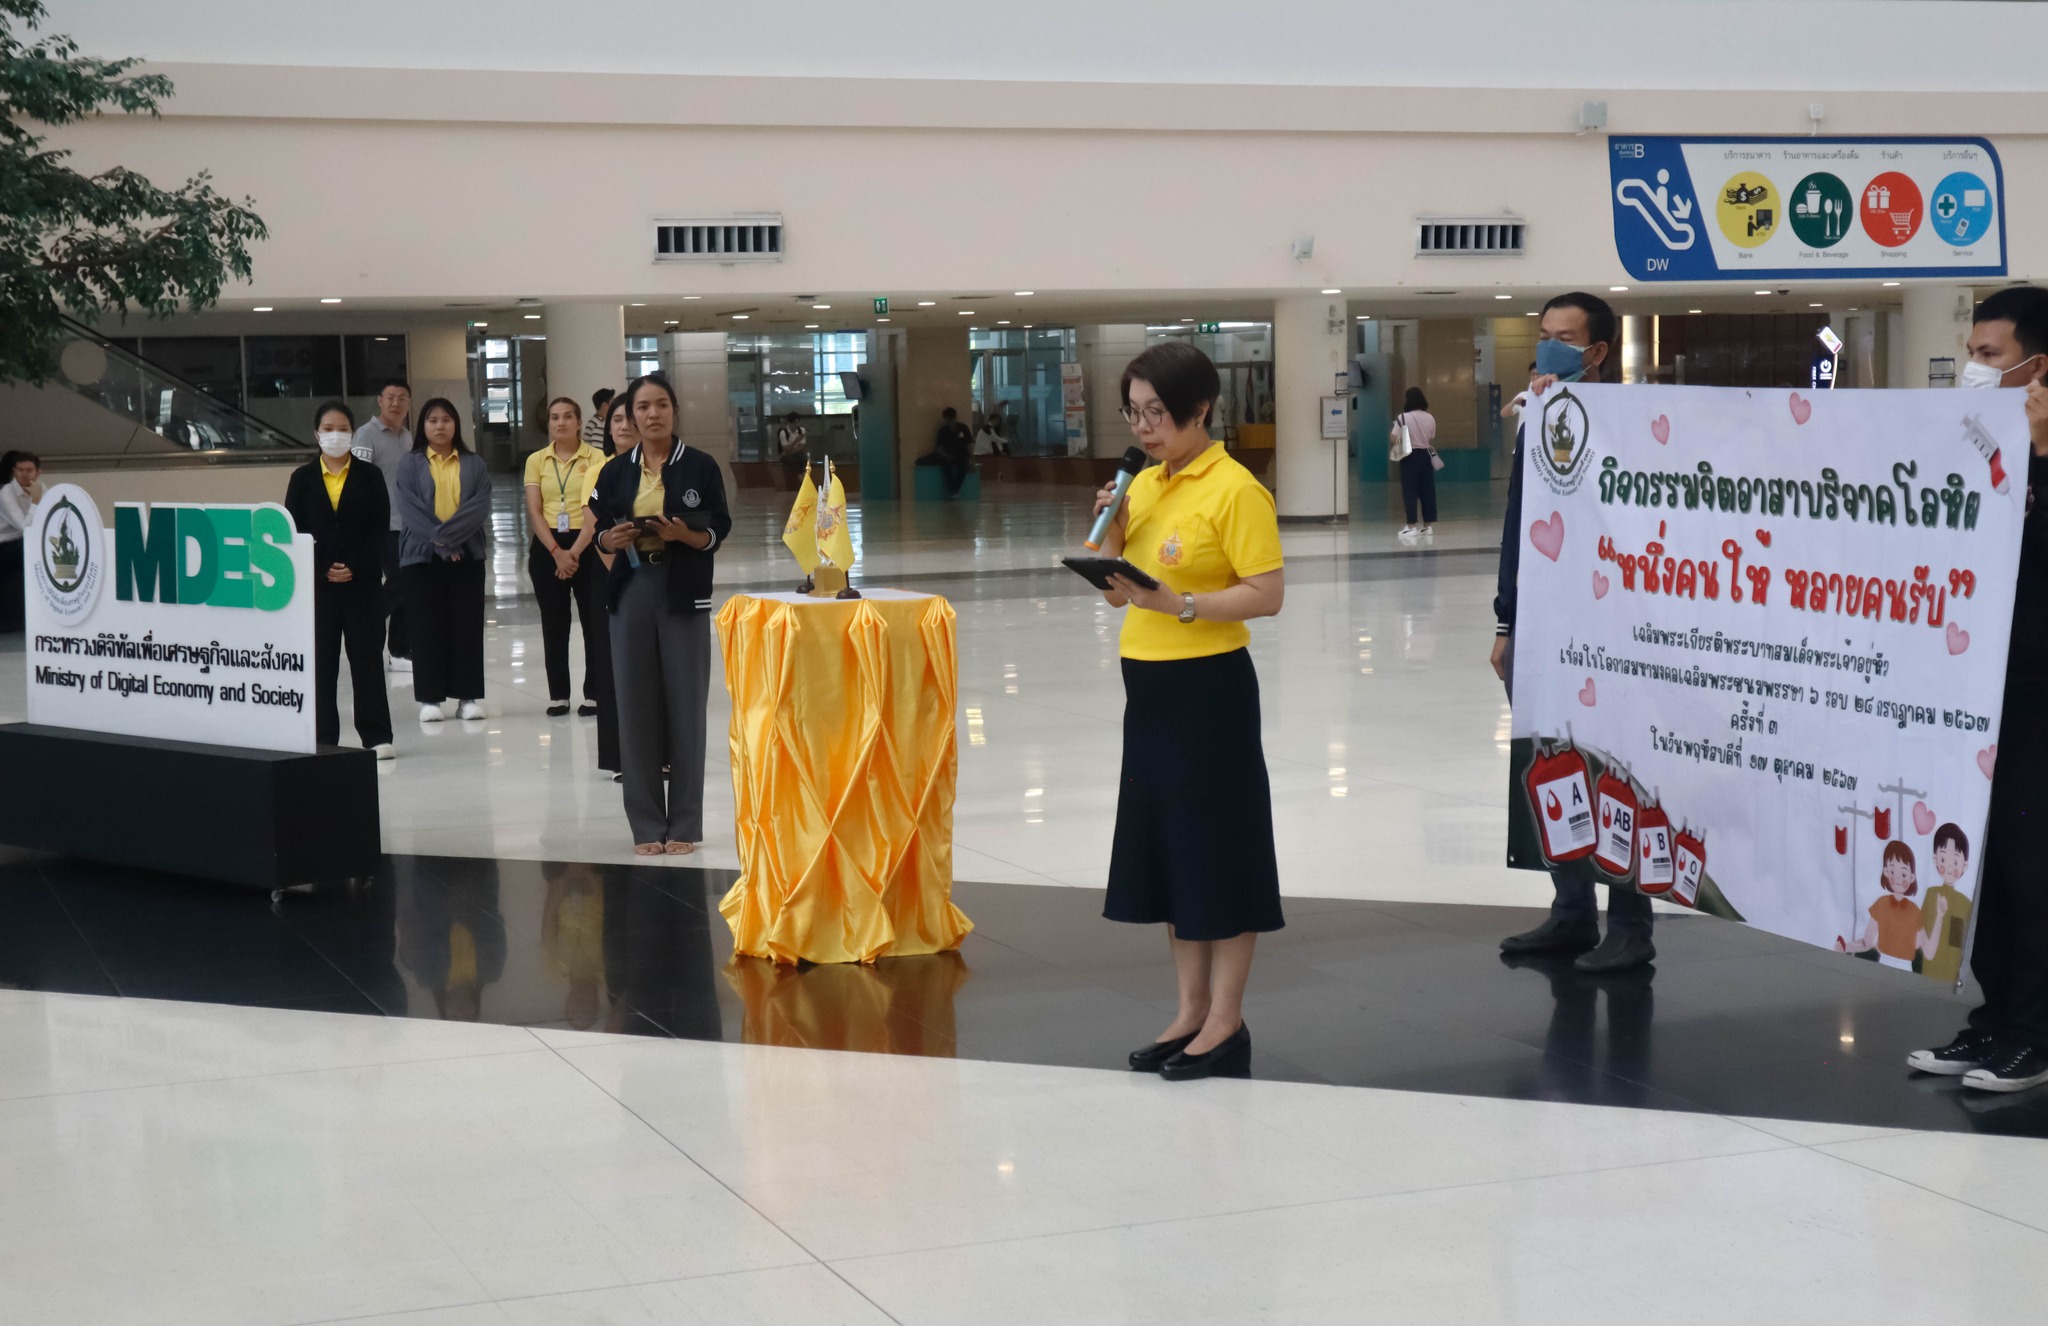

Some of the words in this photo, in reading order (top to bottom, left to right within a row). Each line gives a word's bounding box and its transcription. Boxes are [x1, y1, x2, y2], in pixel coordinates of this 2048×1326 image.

[1634, 144, 1645, 158] B
[1724, 150, 1771, 160] บริการธนาคาร
[1783, 149, 1860, 160] ร้านอาหารและเครื่องดื่ม
[1647, 258, 1669, 271] DW
[1822, 251, 1849, 260] Beverage
[1599, 455, 1981, 531] กิจกรรมจิตอาสาบริจาคโลหิต
[114, 504, 296, 612] MDES
[35, 630, 304, 673] กระทรวงดิจิทัลเพื่อเศรษฐกิจและสังคม
[1633, 622, 1889, 684] เฉลิมพระเกียรติพระบาทสมเด็จพระเจ้าอยู่หัว
[35, 665, 85, 693] Ministry
[91, 670, 103, 689] of
[108, 671, 148, 698] Digital
[154, 675, 214, 705] Economy
[220, 682, 245, 702] and
[252, 683, 304, 713] Society
[1731, 700, 1765, 735] ครั้งที่
[1768, 719, 1778, 735] ๓
[1810, 687, 1819, 705] ๖
[1825, 691, 1848, 711] รอบ
[1876, 698, 1936, 729] กรกฎาคม
[1943, 709, 1991, 732] ๒๕๖๗
[1650, 725, 1743, 769] ในวันพฤหัสบดีที่
[1750, 754, 1768, 771] ๑๗
[1774, 758, 1814, 784] ตุลาคม
[1823, 767, 1858, 791] ๒๕๖๗
[1573, 782, 1583, 806] A
[1613, 807, 1631, 832] AB
[1657, 832, 1666, 850] B
[1690, 860, 1697, 875] O
